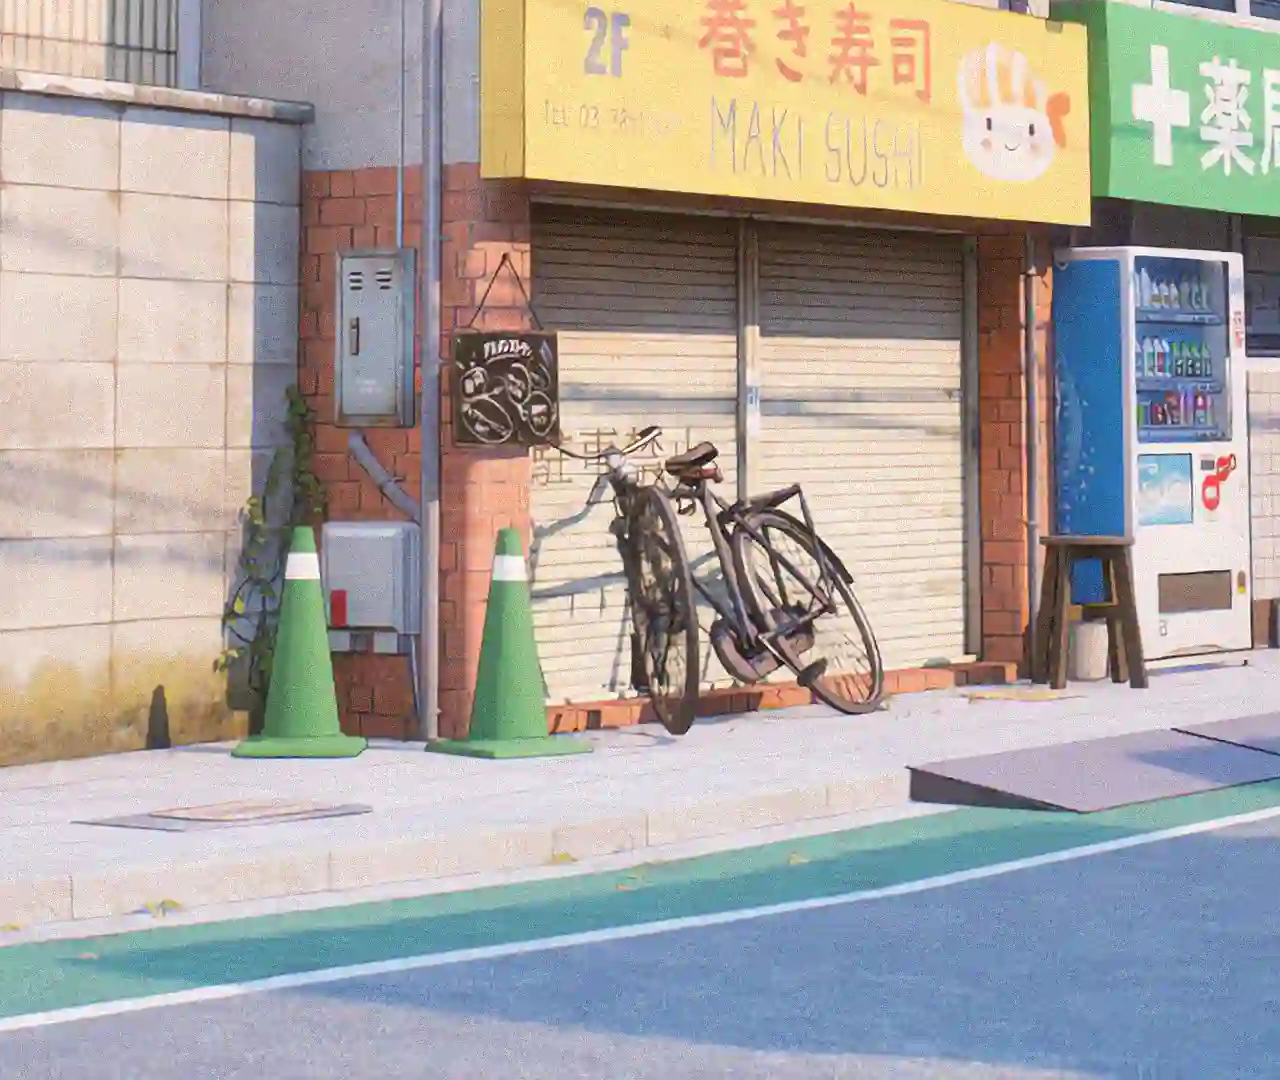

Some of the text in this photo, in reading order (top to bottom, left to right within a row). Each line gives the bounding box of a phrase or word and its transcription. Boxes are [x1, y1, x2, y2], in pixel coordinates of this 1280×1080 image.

[583, 6, 631, 79] 2F
[710, 94, 803, 182] MAKI
[824, 110, 924, 190] SUSHI
